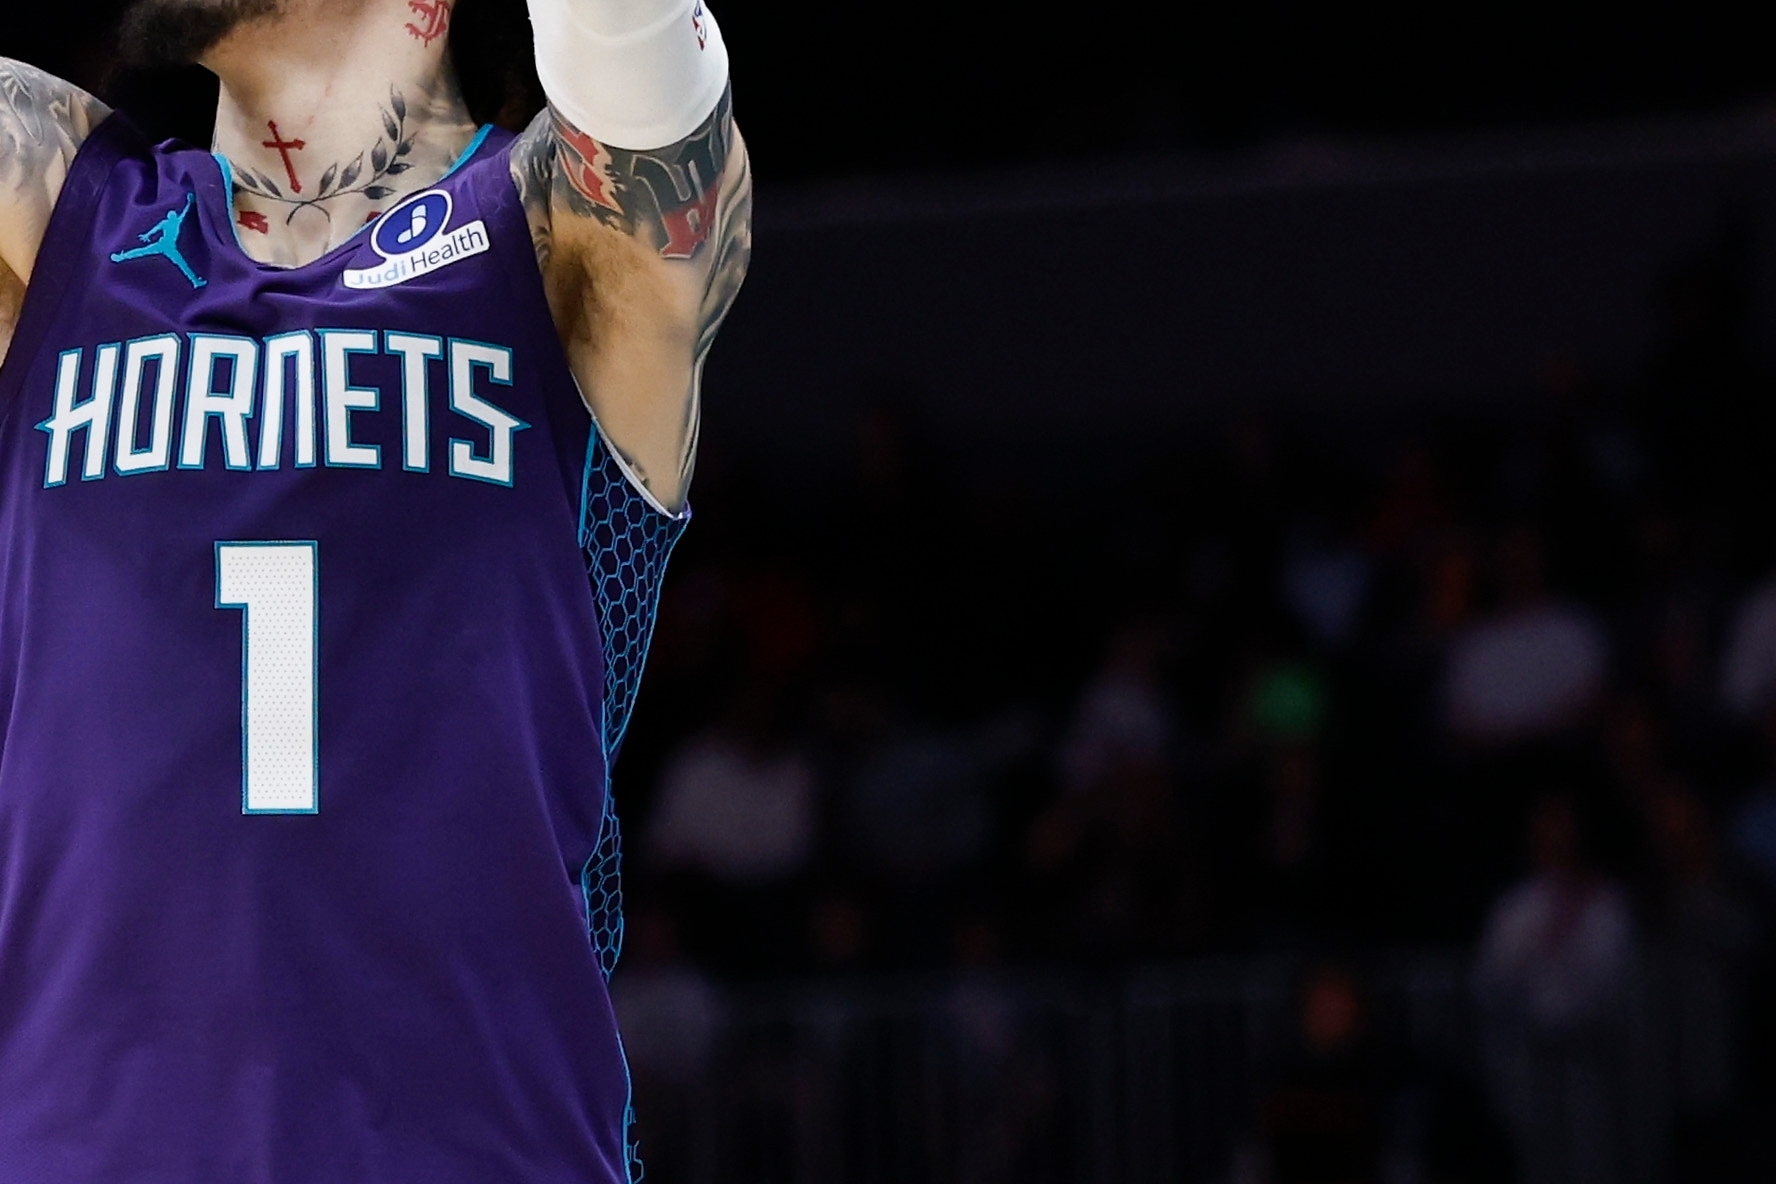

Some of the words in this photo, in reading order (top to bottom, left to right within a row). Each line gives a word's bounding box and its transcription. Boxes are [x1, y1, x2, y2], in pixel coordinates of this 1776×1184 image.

[410, 227, 484, 273] Health
[35, 328, 532, 488] HORNETS
[214, 540, 319, 814] 1
